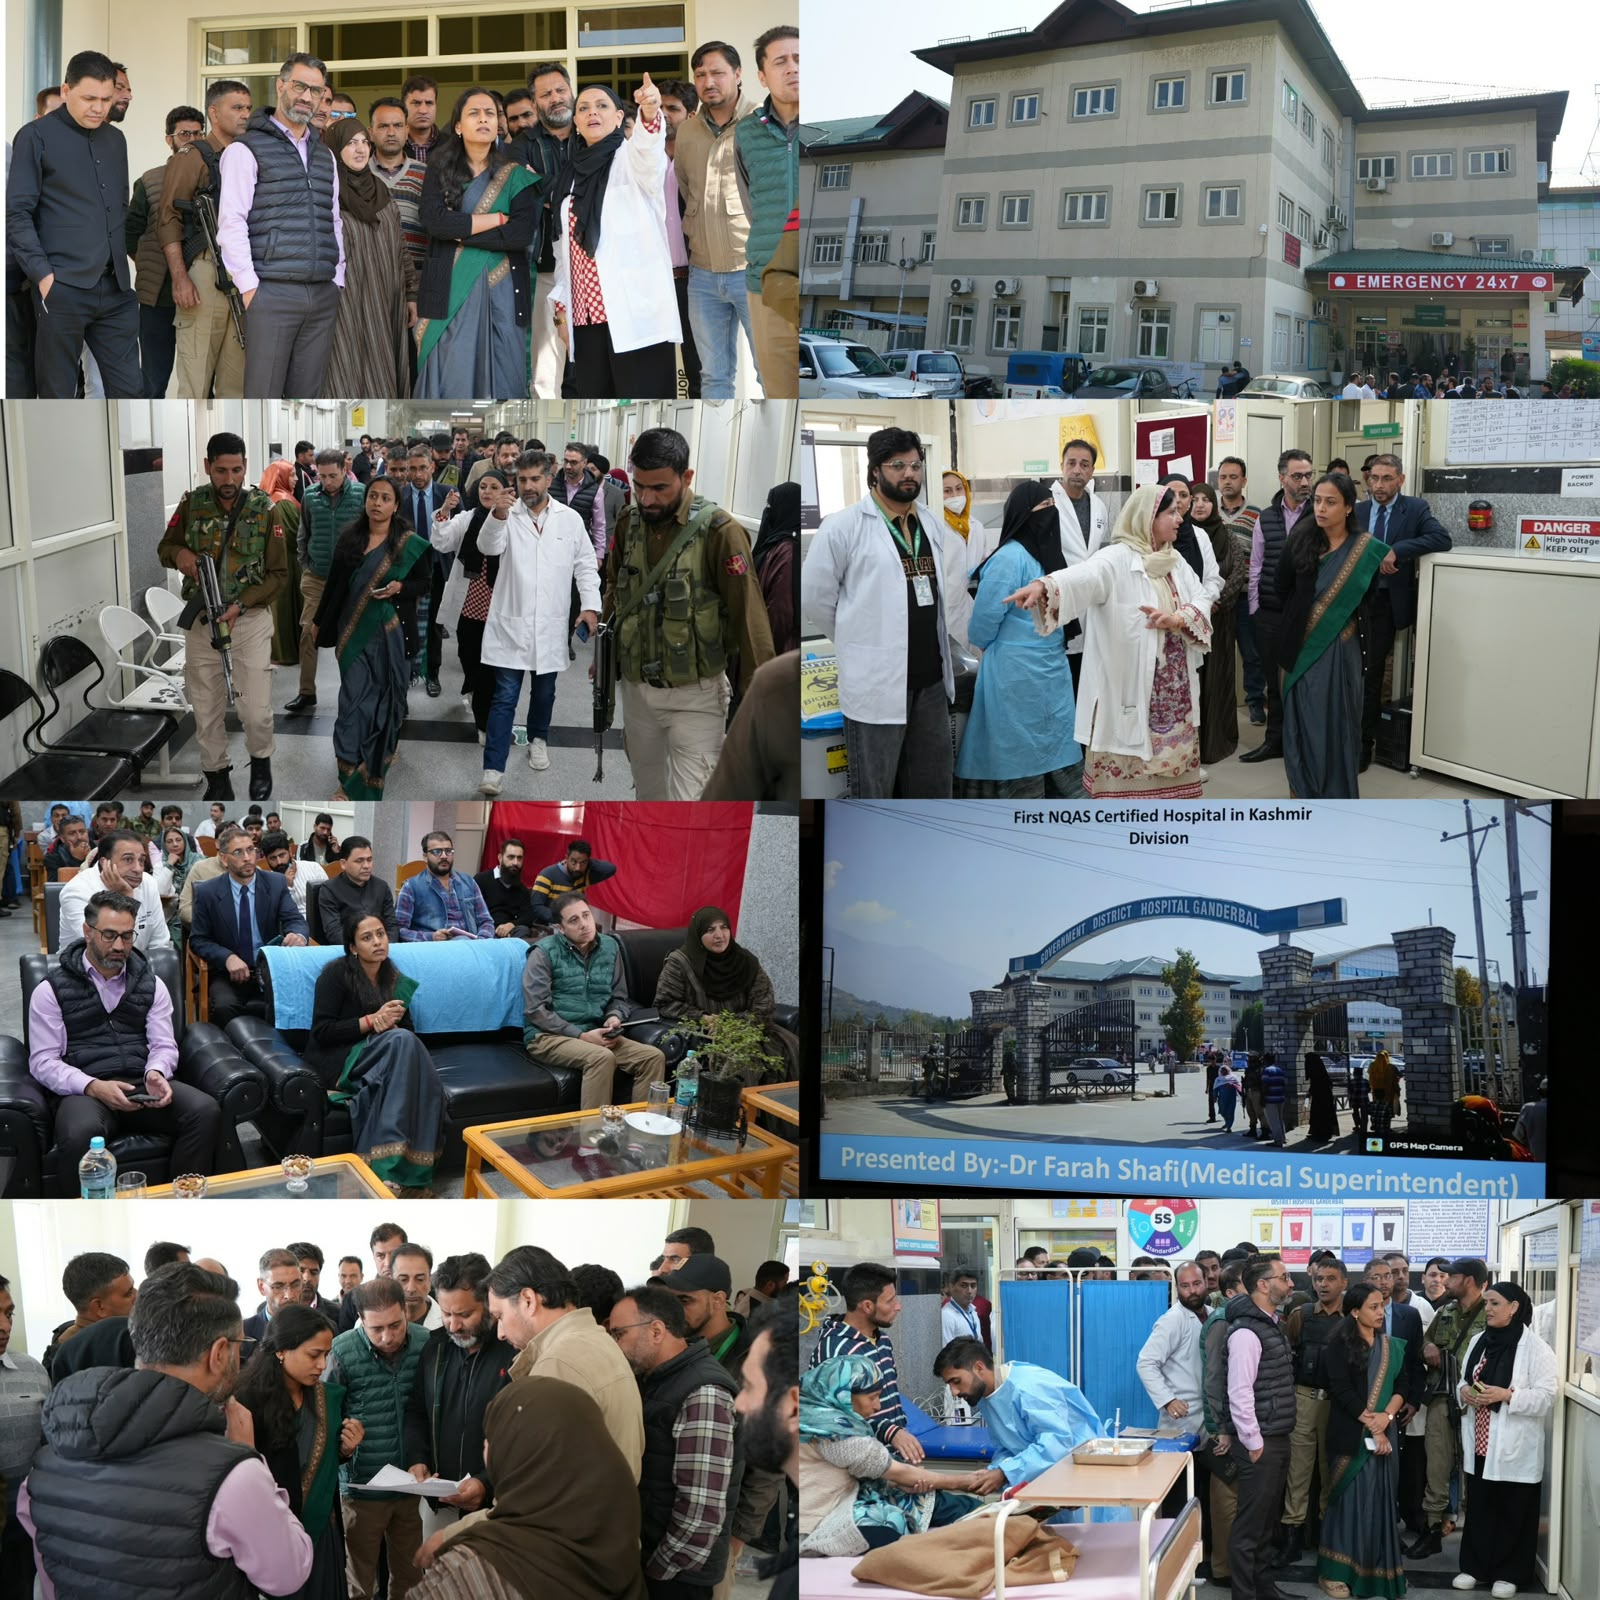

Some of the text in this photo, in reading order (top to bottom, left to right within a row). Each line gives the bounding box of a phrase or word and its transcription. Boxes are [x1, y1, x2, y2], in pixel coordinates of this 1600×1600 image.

[1357, 275, 1519, 289] EMERGENCY 24x7
[1533, 522, 1591, 534] DANGER
[1546, 536, 1600, 546] High voltage
[1014, 807, 1312, 825] First NQAS Certified Hospital in Kashmir
[1129, 831, 1189, 845] Division
[1040, 899, 1260, 965] GOVERNMENT DISTRICT HOSPITAL GANDERBAL
[1410, 1142, 1428, 1151] Map
[1429, 1143, 1463, 1151] Camera
[841, 1146, 956, 1172] Presented
[1044, 1155, 1110, 1179] Farah
[1299, 1165, 1519, 1198] Superintendent)
[1154, 1213, 1172, 1224] 5S
[1145, 1244, 1180, 1254] Standardize
